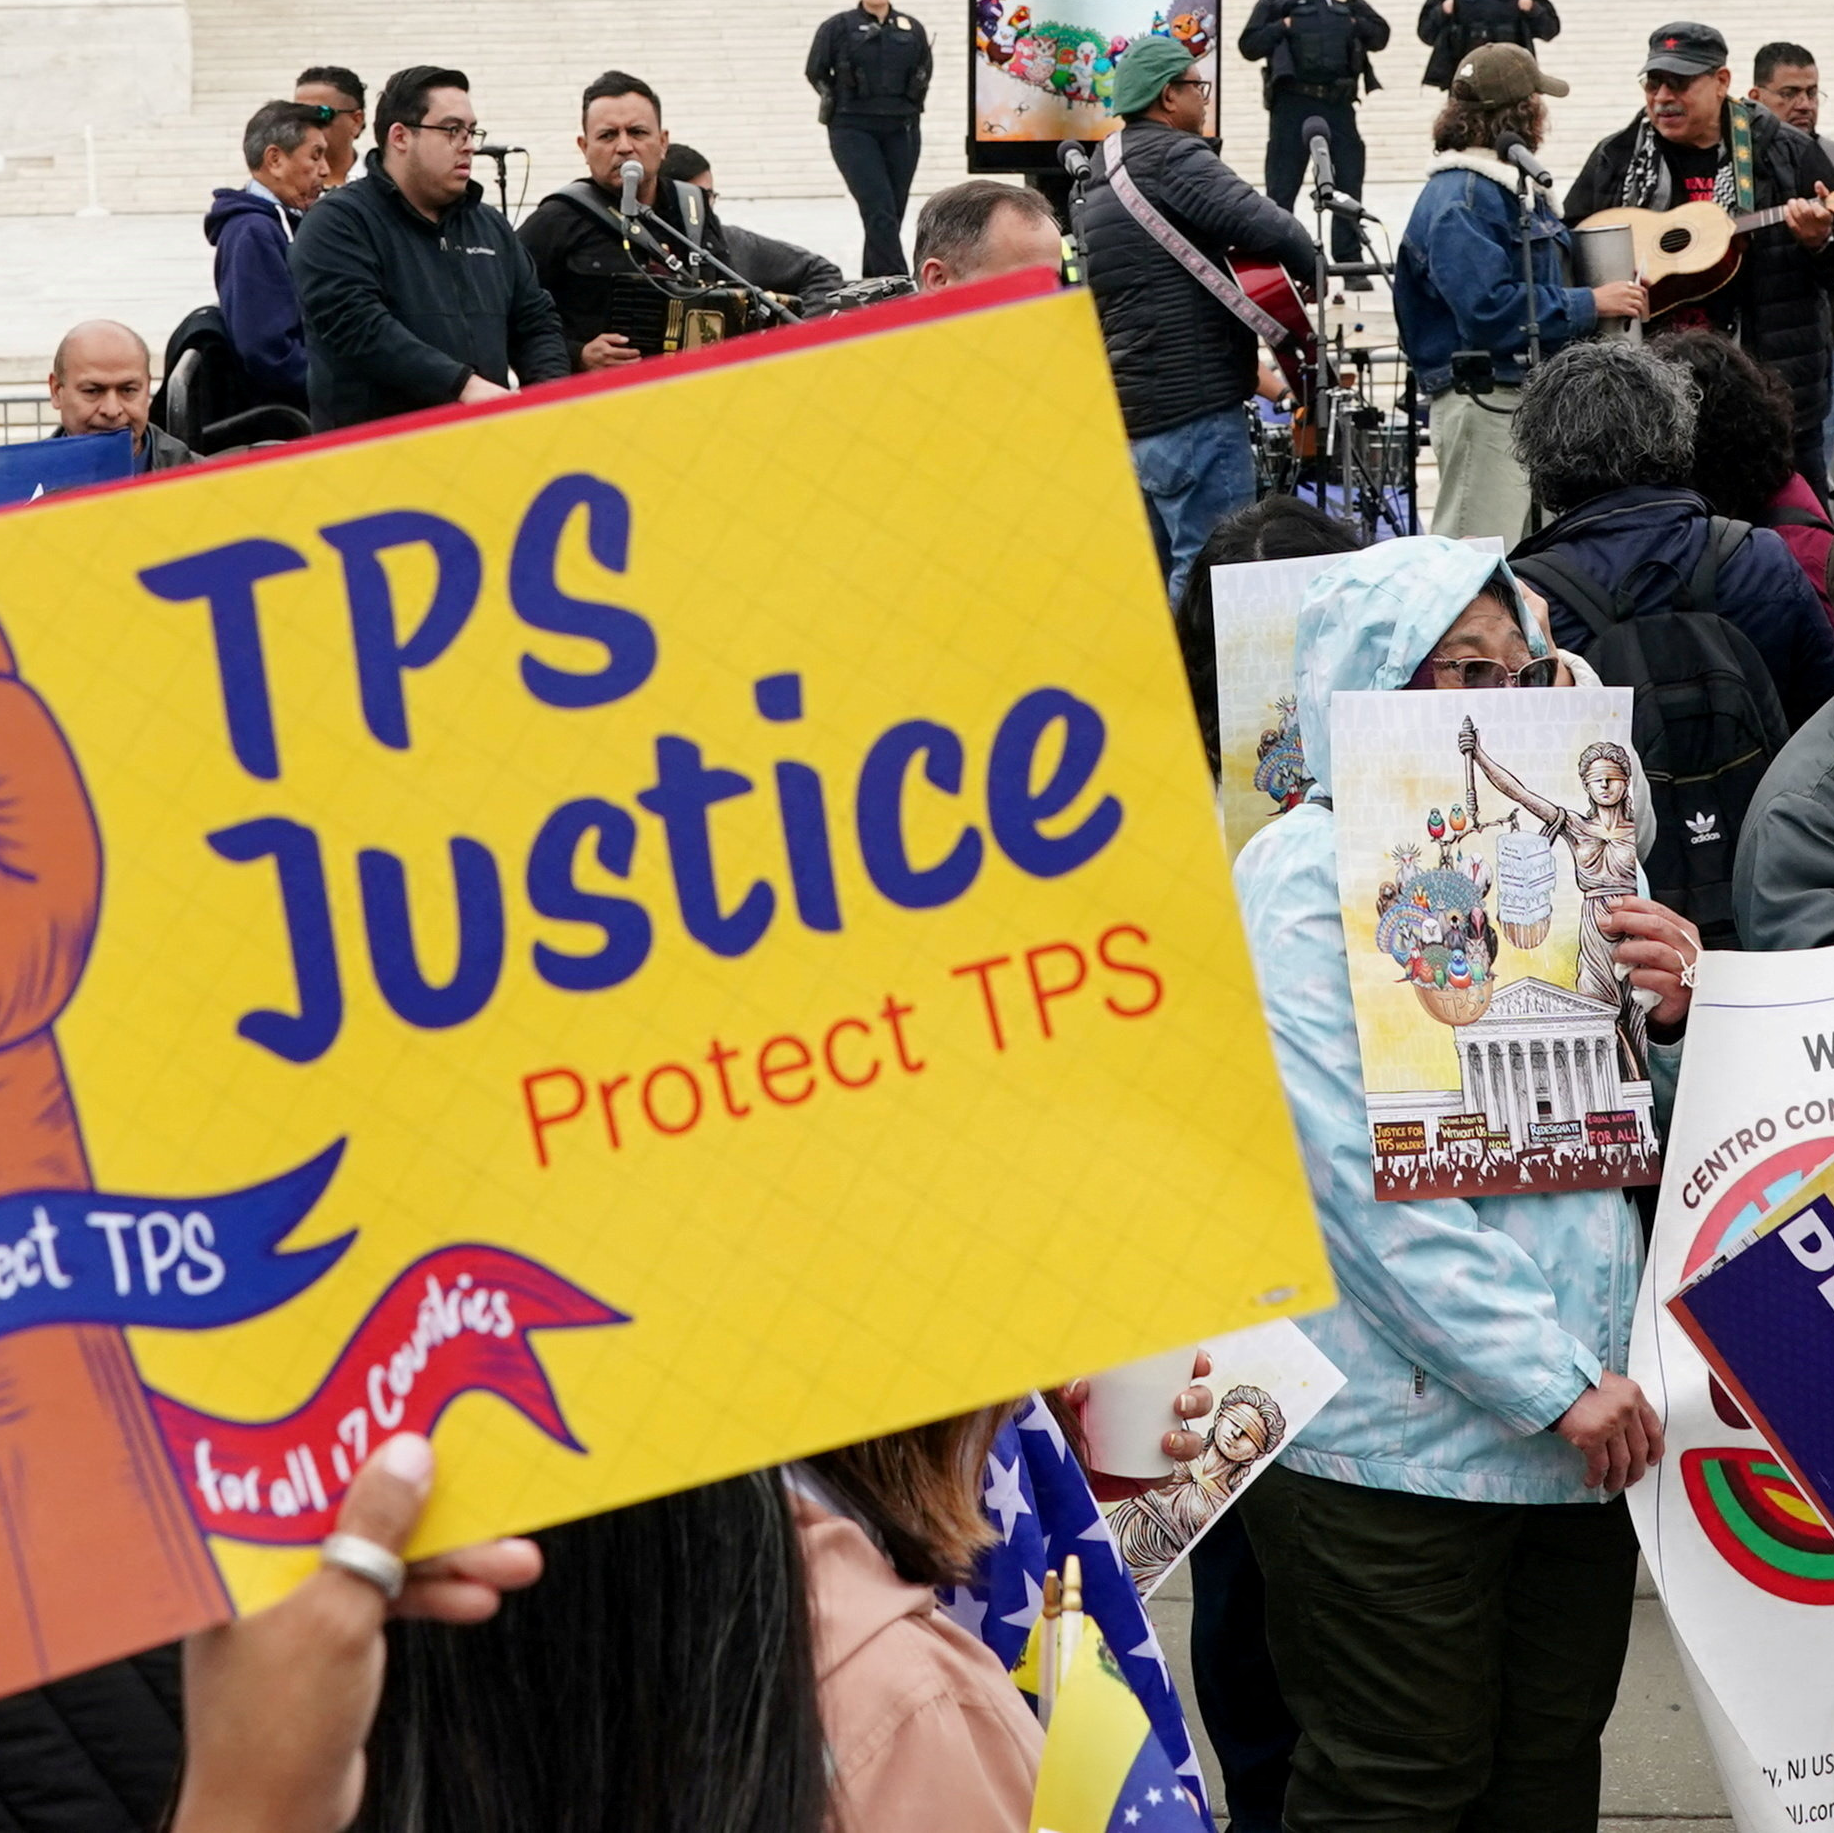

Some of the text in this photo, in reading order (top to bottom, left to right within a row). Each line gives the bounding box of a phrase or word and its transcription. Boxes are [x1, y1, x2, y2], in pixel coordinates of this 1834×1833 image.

[135, 470, 659, 783] TPS
[1690, 831, 1721, 845] adidas
[204, 670, 1124, 1067] Justice
[1438, 992, 1480, 1019] TPS
[519, 922, 1167, 1172] Protect TPS
[1374, 1124, 1425, 1140] JUSTICE FOR
[1440, 1125, 1474, 1139] WITHOUT
[1475, 1125, 1488, 1138] US
[1487, 1140, 1510, 1149] NOW
[1589, 1131, 1615, 1144] FOR
[1617, 1129, 1638, 1142] ALL
[1376, 1139, 1426, 1152] TPS HOLDERS
[1681, 1117, 1778, 1211] CENTRO
[85, 1210, 226, 1298] TPS
[194, 1272, 515, 1518] for all 17 Countries
[1787, 1757, 1807, 1781] NJ
